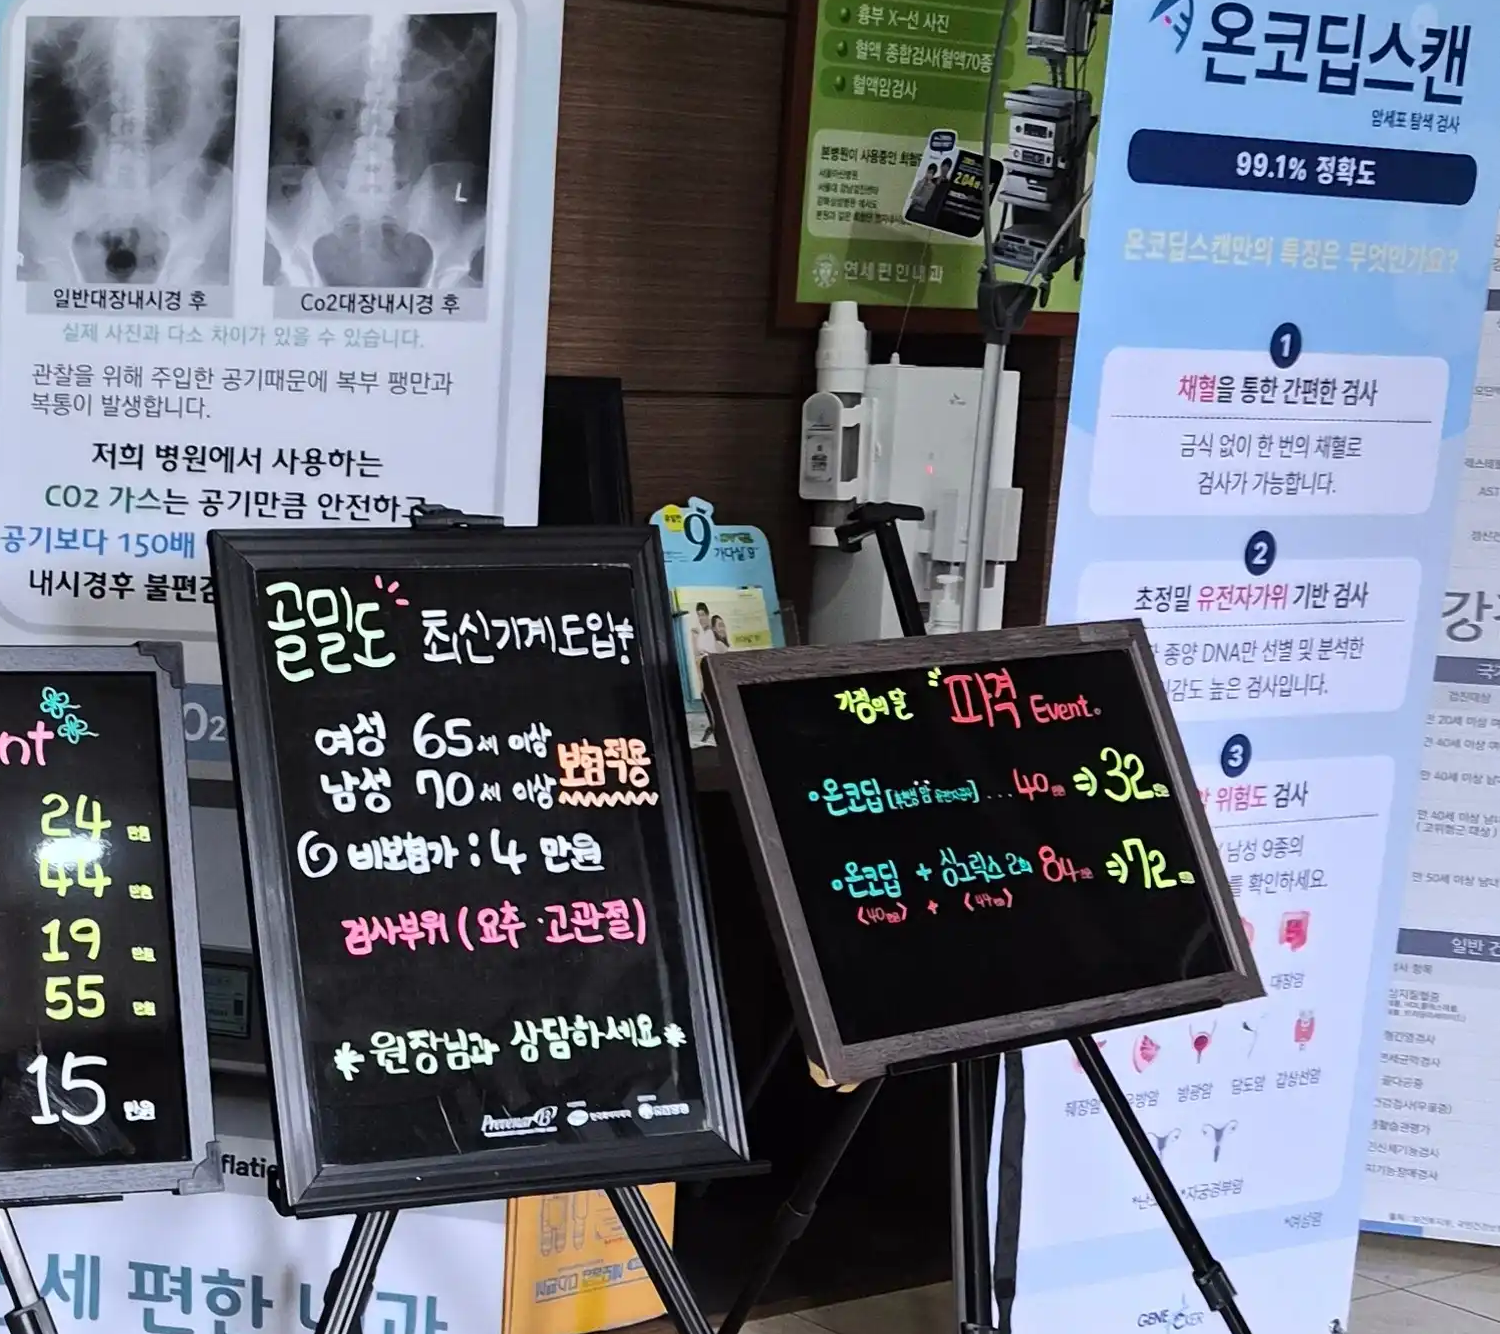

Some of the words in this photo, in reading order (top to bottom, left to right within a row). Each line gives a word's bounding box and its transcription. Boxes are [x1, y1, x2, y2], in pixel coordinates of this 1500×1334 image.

[922, 13, 950, 34] 사진
[1201, 2, 1473, 106] 온코딥스캔
[1436, 113, 1461, 134] 검사
[1235, 150, 1307, 182] 99.1%
[1315, 154, 1377, 187] 정확도
[1123, 228, 1275, 266] 온코딥스캔만의
[53, 288, 182, 312] 일반대장내시경
[188, 289, 208, 312] 후
[300, 290, 434, 316] Co2대장내시경
[441, 292, 460, 316] 후
[105, 322, 161, 346] 사진과
[167, 323, 203, 347] 다소
[212, 324, 267, 348] 차이가
[317, 326, 337, 349] 수
[1278, 332, 1293, 357] 1
[31, 363, 94, 388] 관찰을
[101, 364, 143, 389] 위해
[150, 365, 214, 391] 주입한
[221, 366, 328, 393] 공기때문에
[336, 369, 379, 394] 복부
[387, 369, 453, 396] 팽만과
[1178, 373, 1236, 404] 채혈을
[1240, 375, 1279, 405] 통한
[1282, 376, 1339, 407] 간편한
[1341, 378, 1379, 408] 검사
[30, 393, 93, 418] 복통이
[101, 394, 212, 420] 발생합니다.
[92, 442, 144, 470] 저희
[155, 443, 262, 476] 병원에서
[272, 447, 384, 479] 사용하는
[1180, 432, 1214, 460] 금식
[1220, 432, 1253, 460] 없이
[1257, 433, 1275, 460] 한
[1279, 433, 1310, 460] 번의
[1314, 433, 1364, 460] 채혈로
[44, 483, 99, 510] CO2
[108, 485, 189, 515] 가스는
[197, 487, 308, 521] 공기만큼
[1197, 470, 1248, 498] 검사가
[1252, 470, 1337, 497] 가능합니다.
[0, 525, 108, 557] 공기보다
[117, 528, 196, 560] 150배
[683, 513, 712, 562] 9
[1251, 541, 1270, 566] 2
[29, 569, 135, 602] 내시경후
[1135, 584, 1192, 614] 초정밀
[1196, 580, 1289, 612] 유전자가위
[1293, 580, 1330, 610] 기반
[1333, 580, 1370, 610] 검사
[265, 579, 396, 683] 골밀도
[1442, 590, 1500, 643] 강
[1163, 640, 1199, 668] 종양
[1202, 639, 1257, 666] DNA만
[1262, 637, 1294, 664] 선별
[1297, 637, 1315, 663] 및
[1318, 635, 1365, 662] 분석한
[942, 667, 1023, 729] 파격
[1209, 677, 1240, 702] 높은
[1246, 674, 1329, 701] 검사입니다.
[314, 711, 388, 760] 여성
[413, 713, 499, 758] 65세
[508, 722, 552, 755] 이상
[557, 739, 652, 789] 보험적용
[1228, 743, 1245, 767] 3
[320, 766, 393, 815] 남성
[415, 768, 502, 810] 70세
[513, 776, 556, 810] 이상
[822, 777, 884, 816] 온코딥
[1215, 783, 1268, 813] 위험도
[1273, 781, 1309, 809] 검사
[40, 793, 112, 841] 24
[540, 833, 604, 873] 만원
[1227, 838, 1258, 864] 남성
[1262, 834, 1305, 860] 9종의
[39, 857, 112, 898] 44
[843, 859, 902, 899] 온코딥
[938, 846, 1007, 888] 싱그릭스
[41, 918, 101, 962] 19
[340, 908, 450, 957] 검사부위
[45, 974, 106, 1021] 55
[369, 1029, 500, 1076] 원장님과
[510, 1013, 662, 1061] 상담하세요
[26, 1050, 107, 1126] 15
